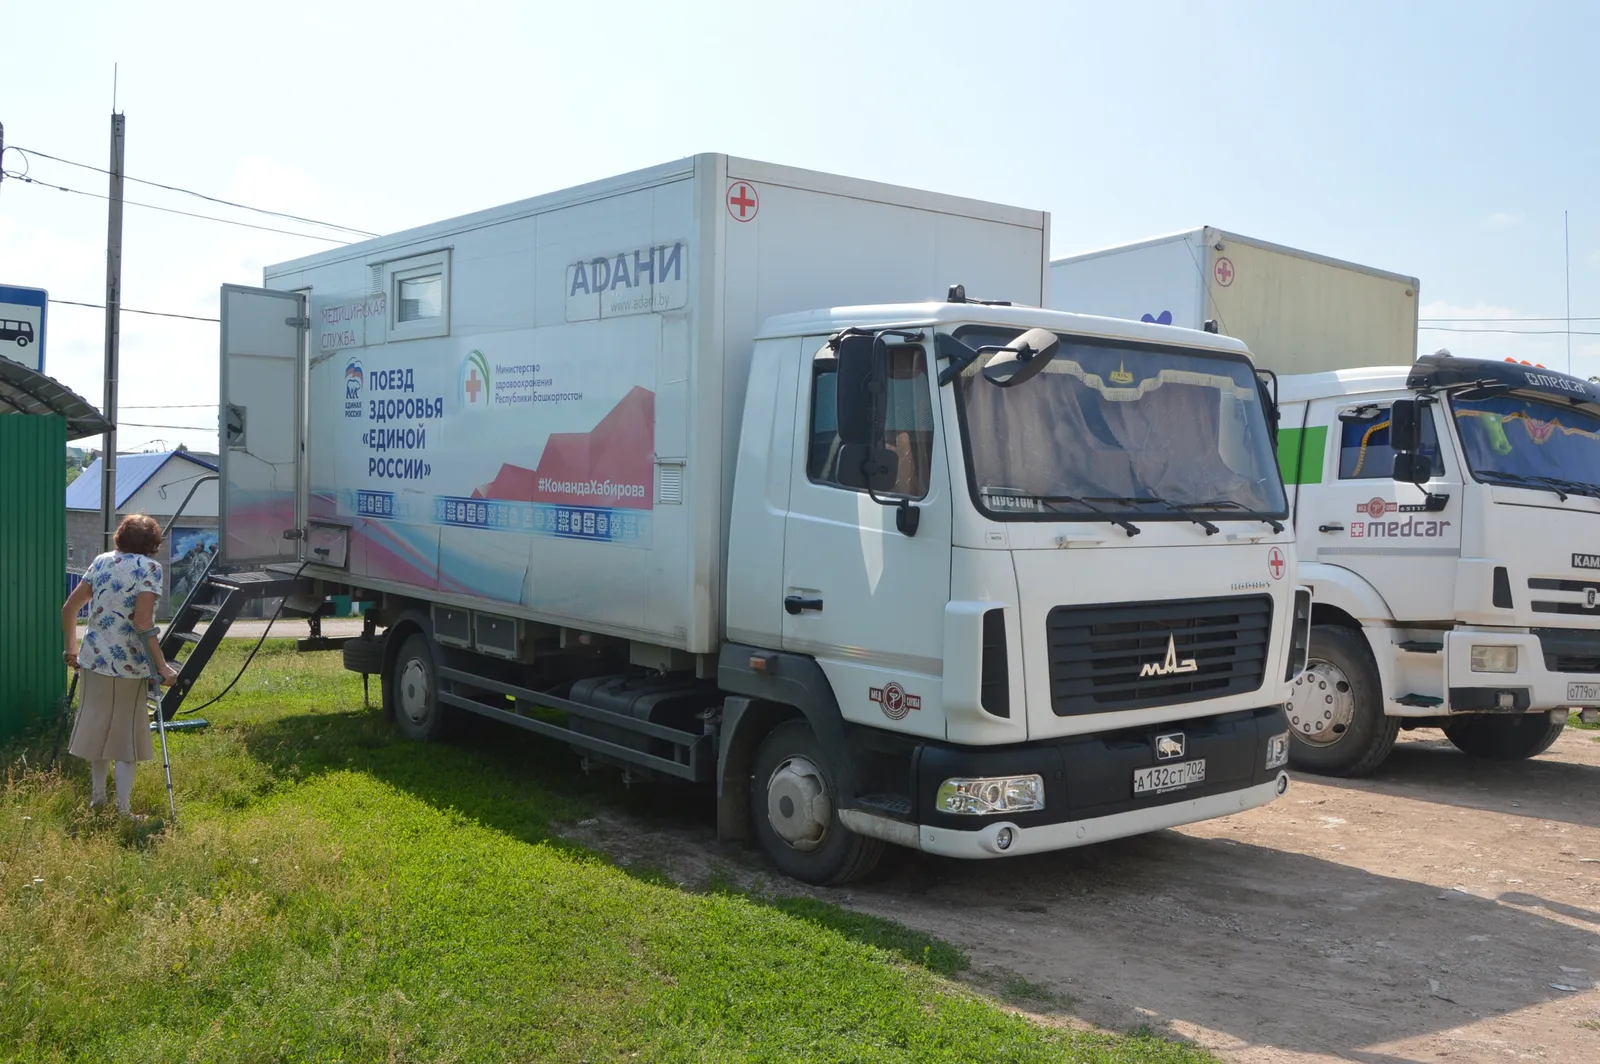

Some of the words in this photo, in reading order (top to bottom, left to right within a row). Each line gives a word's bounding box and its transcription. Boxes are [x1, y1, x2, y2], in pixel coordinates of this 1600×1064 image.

[321, 299, 386, 324] МЕДИЦИНСКАЯ
[321, 330, 356, 349] СЛУЖБА
[495, 363, 540, 375] Министерство
[369, 368, 415, 393] ПОЕЗД
[495, 377, 553, 391] здравоохранения
[1537, 373, 1586, 394] medcar
[345, 402, 362, 410] ЕДИНАЯ
[369, 397, 443, 423] ЗДОРОВЬЯ
[495, 392, 532, 407] Республики
[533, 391, 583, 405] Башкортостан
[362, 423, 426, 452] «ЕДИНОЙ
[368, 457, 432, 480] РОССИИ»
[538, 477, 645, 500] #КомандаХабирова
[1367, 515, 1452, 537] medcar
